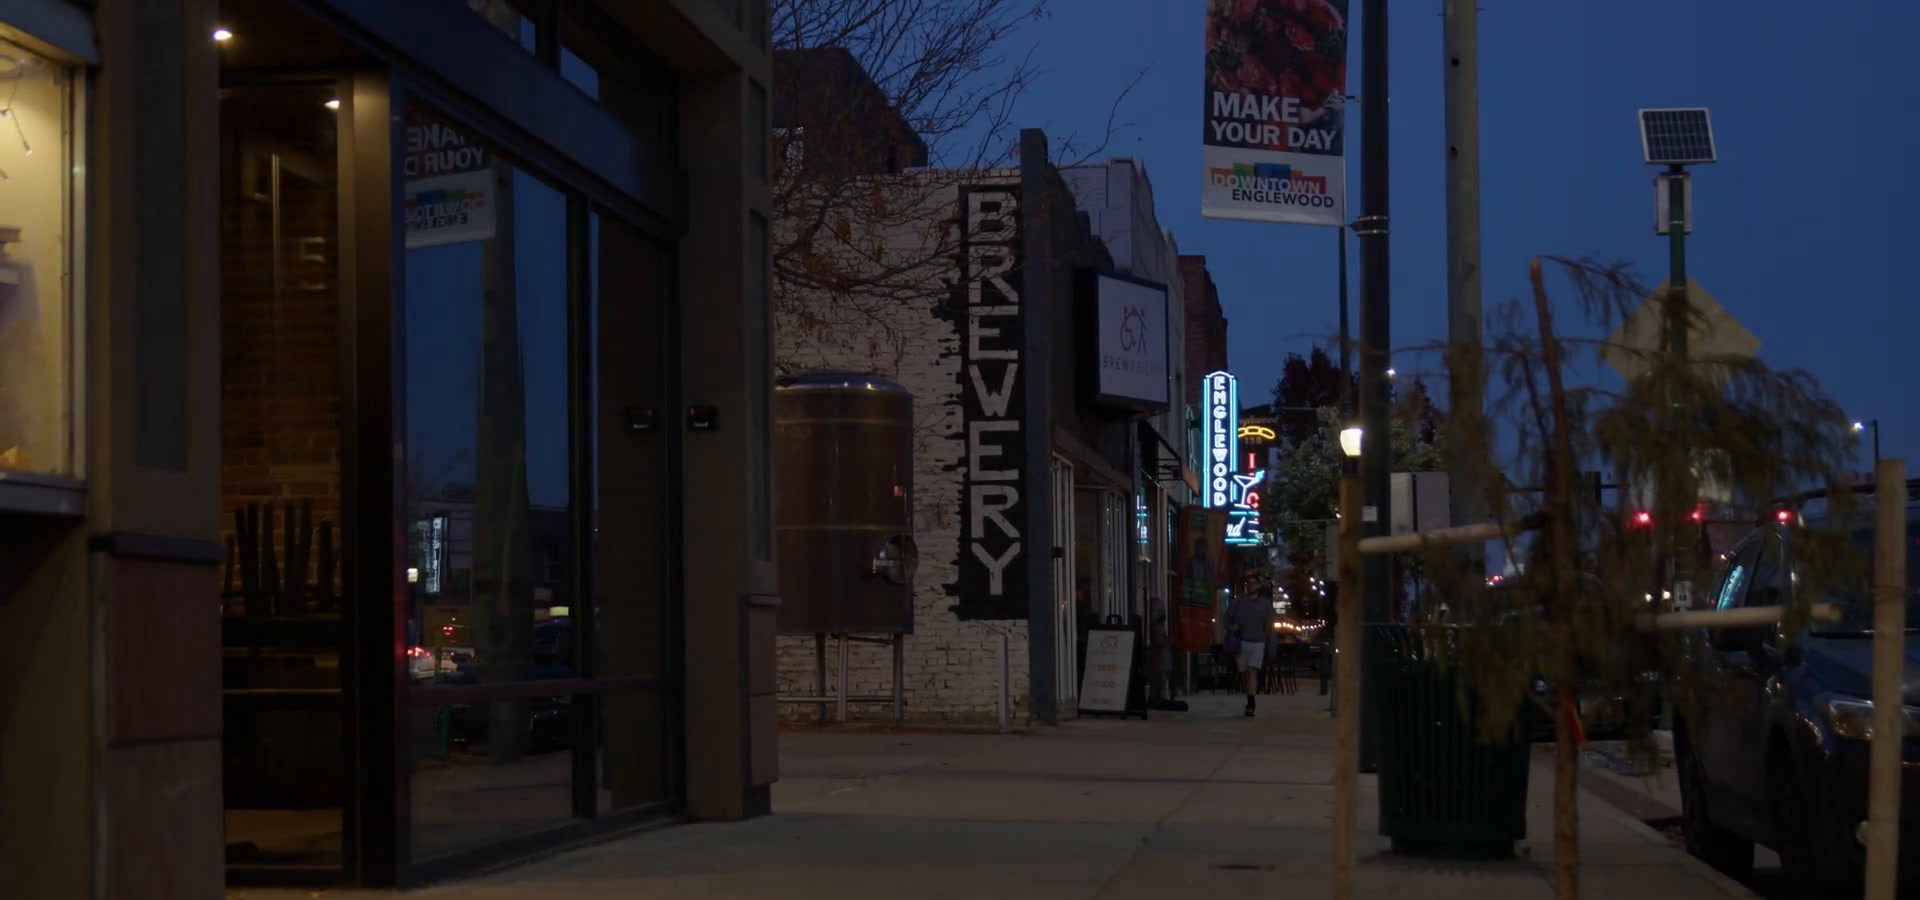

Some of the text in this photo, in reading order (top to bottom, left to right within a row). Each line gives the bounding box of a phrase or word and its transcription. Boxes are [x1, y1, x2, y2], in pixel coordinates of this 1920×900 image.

[1212, 91, 1300, 124] MAKE
[1210, 120, 1336, 151] YOUR DAY
[1212, 173, 1321, 195] DOWNTOWN
[1232, 188, 1334, 208] ENGLEWOOD
[968, 191, 1021, 596] BREWERY
[1212, 375, 1228, 507] ENGLEWOOD
